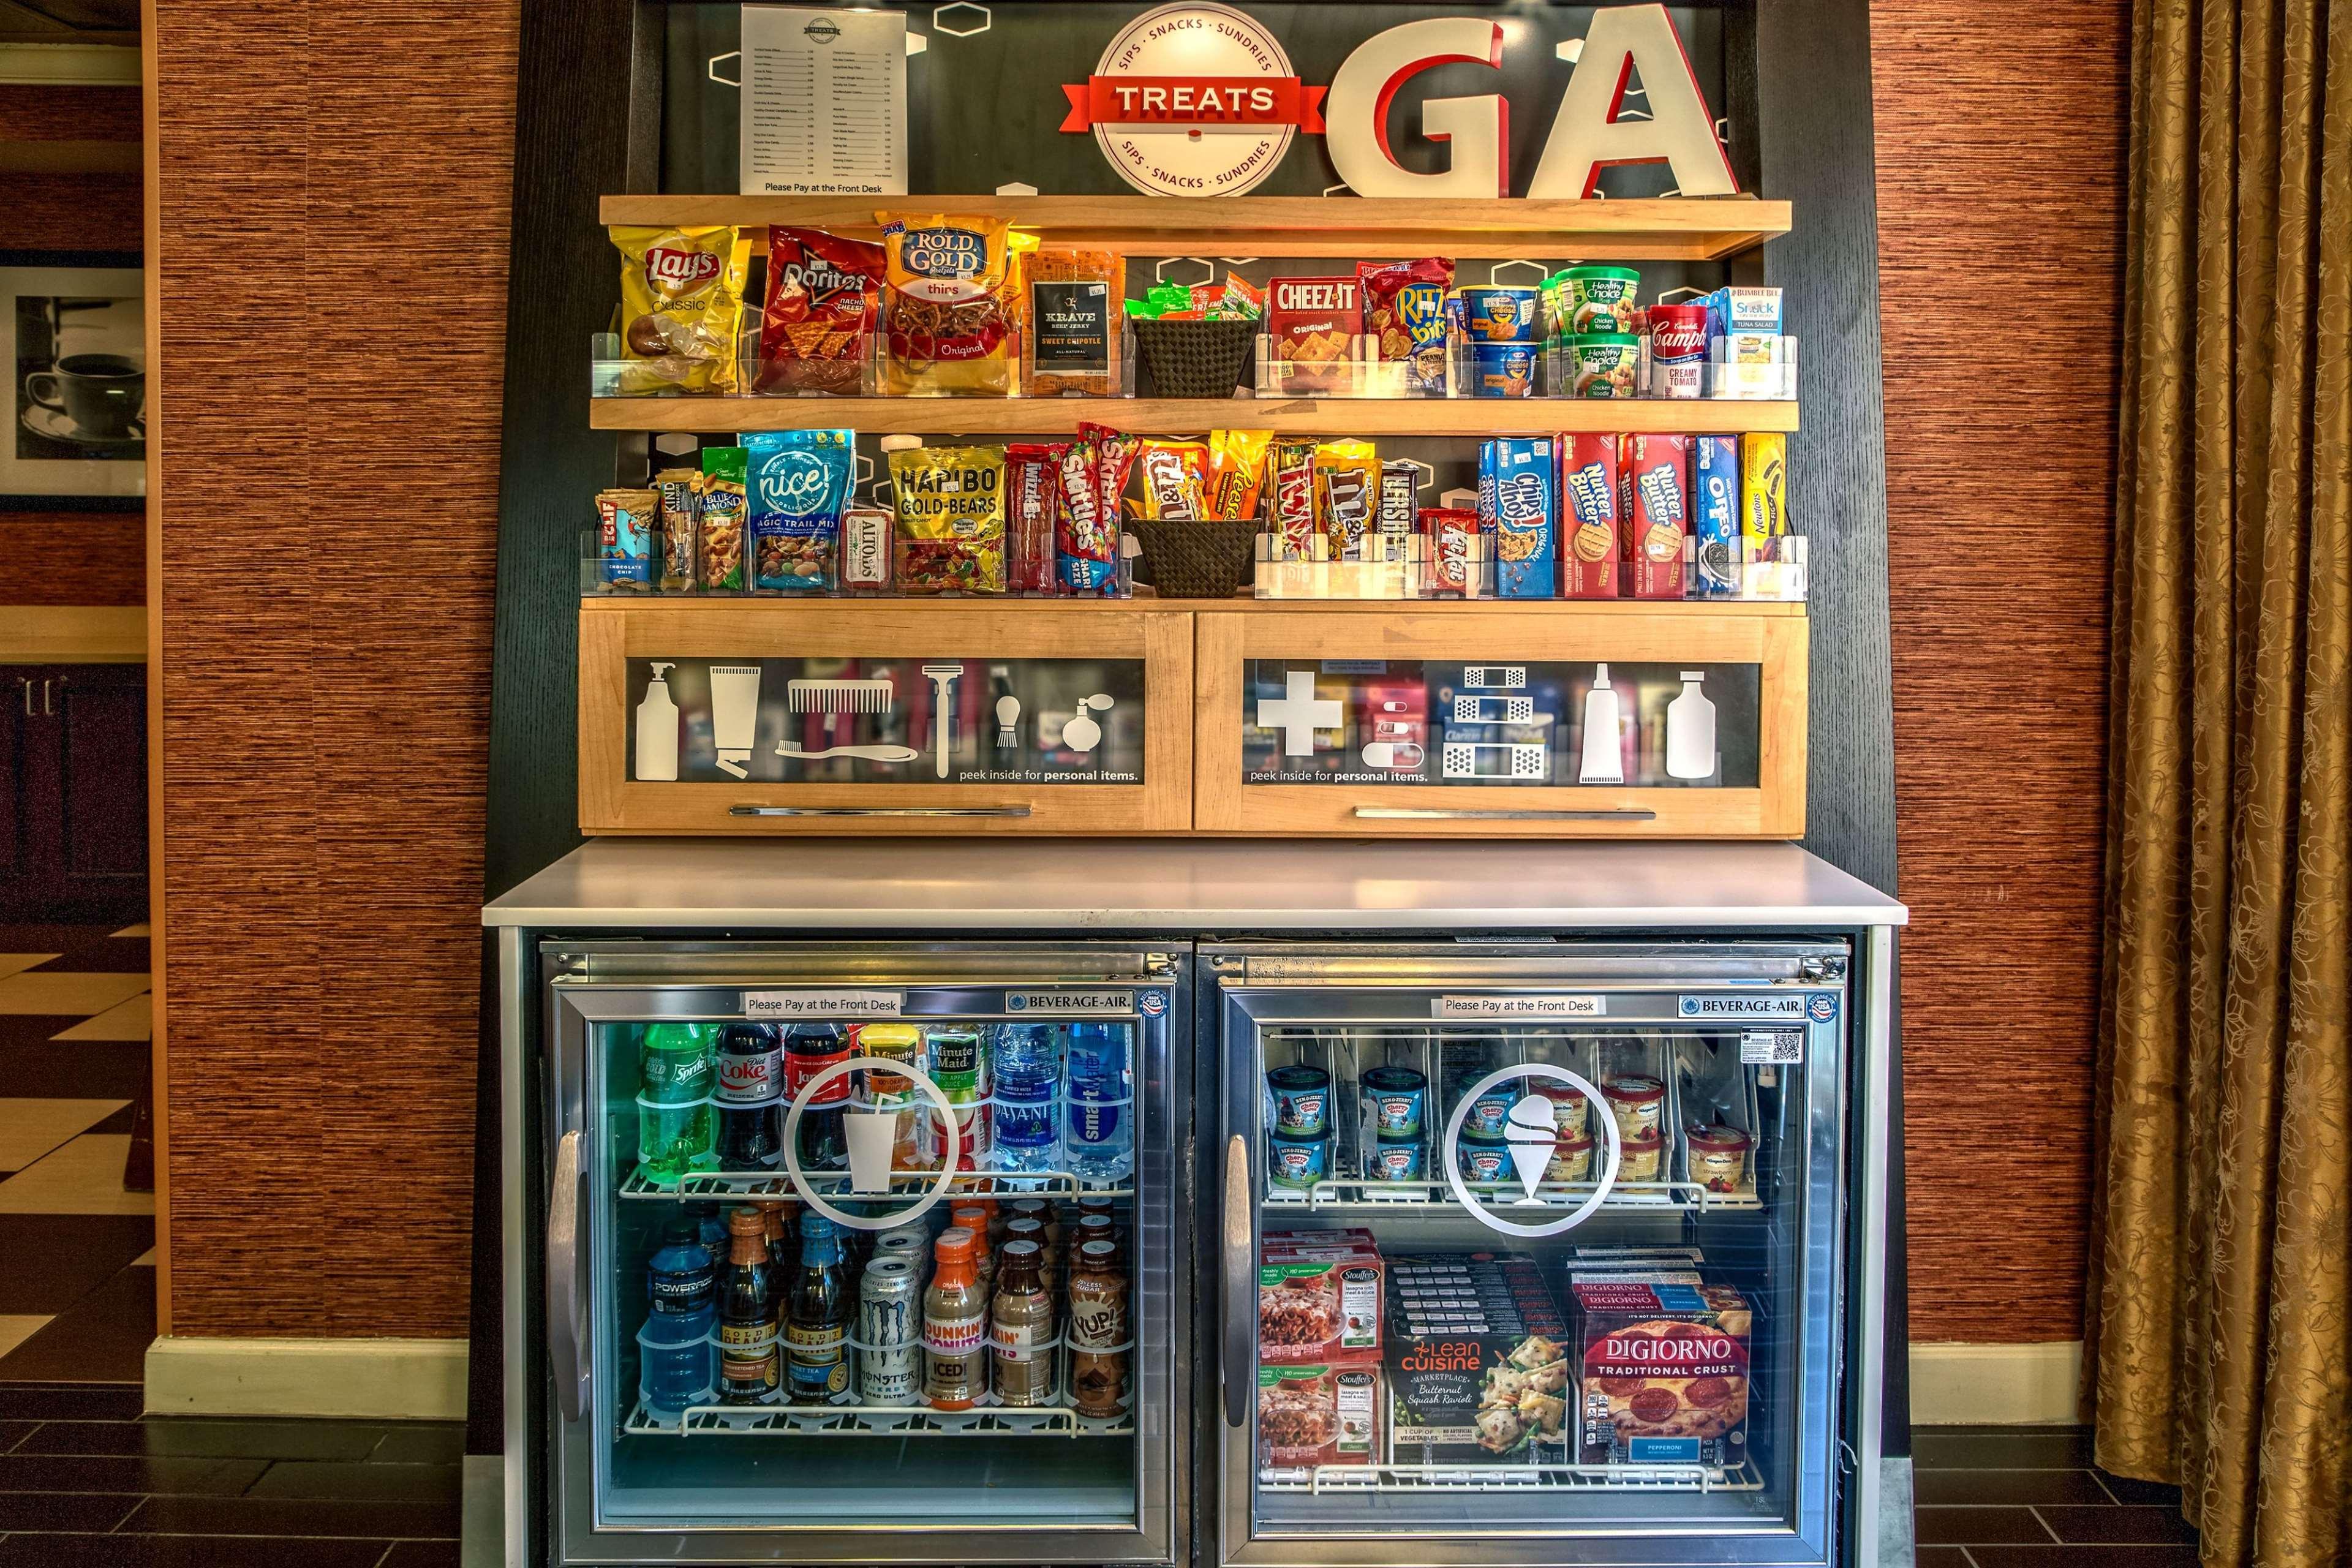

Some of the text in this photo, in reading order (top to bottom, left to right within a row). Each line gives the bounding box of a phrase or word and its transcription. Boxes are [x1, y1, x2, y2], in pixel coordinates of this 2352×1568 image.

[1119, 19, 1272, 72] SIPS SNACKS SUNDRIES
[1116, 86, 1273, 111] TREATS
[1122, 141, 1270, 188] SIPS SNACKS SUNDRIES
[918, 232, 974, 251] ROLD
[910, 250, 978, 271] GOLD
[783, 263, 867, 290] Doritos
[928, 284, 959, 295] thins
[1586, 289, 1621, 298] Choice
[1592, 282, 1623, 292] Healthy
[1398, 288, 1445, 325] RITZ
[1046, 313, 1096, 322] KRAVE
[941, 344, 984, 356] Original
[1588, 350, 1621, 360] Healthy
[1583, 357, 1617, 368] Choice
[1670, 369, 1697, 377] CREAMY
[1670, 377, 1697, 386] TOMATO
[900, 467, 995, 493] HARIBO
[665, 482, 676, 513] KIND
[1023, 462, 1042, 519] Twizzls
[1516, 474, 1542, 517] Chips
[1569, 472, 1600, 524] Butter
[1585, 463, 1611, 518] Nutter
[1655, 464, 1681, 519] Nutter
[706, 494, 729, 503] BLUE
[778, 498, 815, 510] DELICIOUS
[901, 497, 997, 515] GOLD-BEARS
[1062, 454, 1095, 550] Skittles
[1640, 473, 1670, 525] Butter
[602, 502, 615, 535] CLIF
[1754, 493, 1766, 533] Newtons
[862, 521, 876, 578] ALTOIDS
[1530, 528, 1547, 562] ORIGINAL
[1072, 562, 1080, 585] SIZE
[960, 770, 1138, 782] peek inside for personal items.
[1250, 771, 1428, 783] peek inside for personal items.
[748, 998, 895, 1012] Please Pay at the Front Desk
[1029, 995, 1129, 1009] BEVERAGE-AIR
[1446, 998, 1594, 1014] Please Pay at the Front Desk
[1702, 1000, 1800, 1012] BEVERAGE-AIR
[932, 1045, 973, 1057] Minute
[747, 1057, 766, 1066] Diet
[937, 1057, 967, 1068] Maid
[676, 1059, 706, 1082] Sprite
[720, 1060, 766, 1079] Coke
[1083, 1051, 1100, 1140] smartwater
[995, 1105, 1047, 1123] DASANI
[1301, 1102, 1319, 1111] Cherry
[1345, 1270, 1375, 1280] Stouffer's
[1076, 1284, 1101, 1292] SUGAR
[925, 1322, 981, 1339] DUNKIN'
[1075, 1308, 1115, 1338] YUP!
[724, 1329, 763, 1338] GOLD
[790, 1331, 826, 1340] GOLD
[1431, 1341, 1480, 1357] Lean
[1607, 1339, 1731, 1360] DIGIORNO
[934, 1362, 963, 1377] ICED
[1598, 1365, 1735, 1375] TRADITIONAL CRUST
[861, 1370, 916, 1385] MONSTER
[1340, 1374, 1371, 1384] Stouffer's
[1414, 1373, 1468, 1383] MARKETPLACE
[1419, 1385, 1461, 1394] Butternut
[1408, 1395, 1472, 1406] Squash Ravioli
